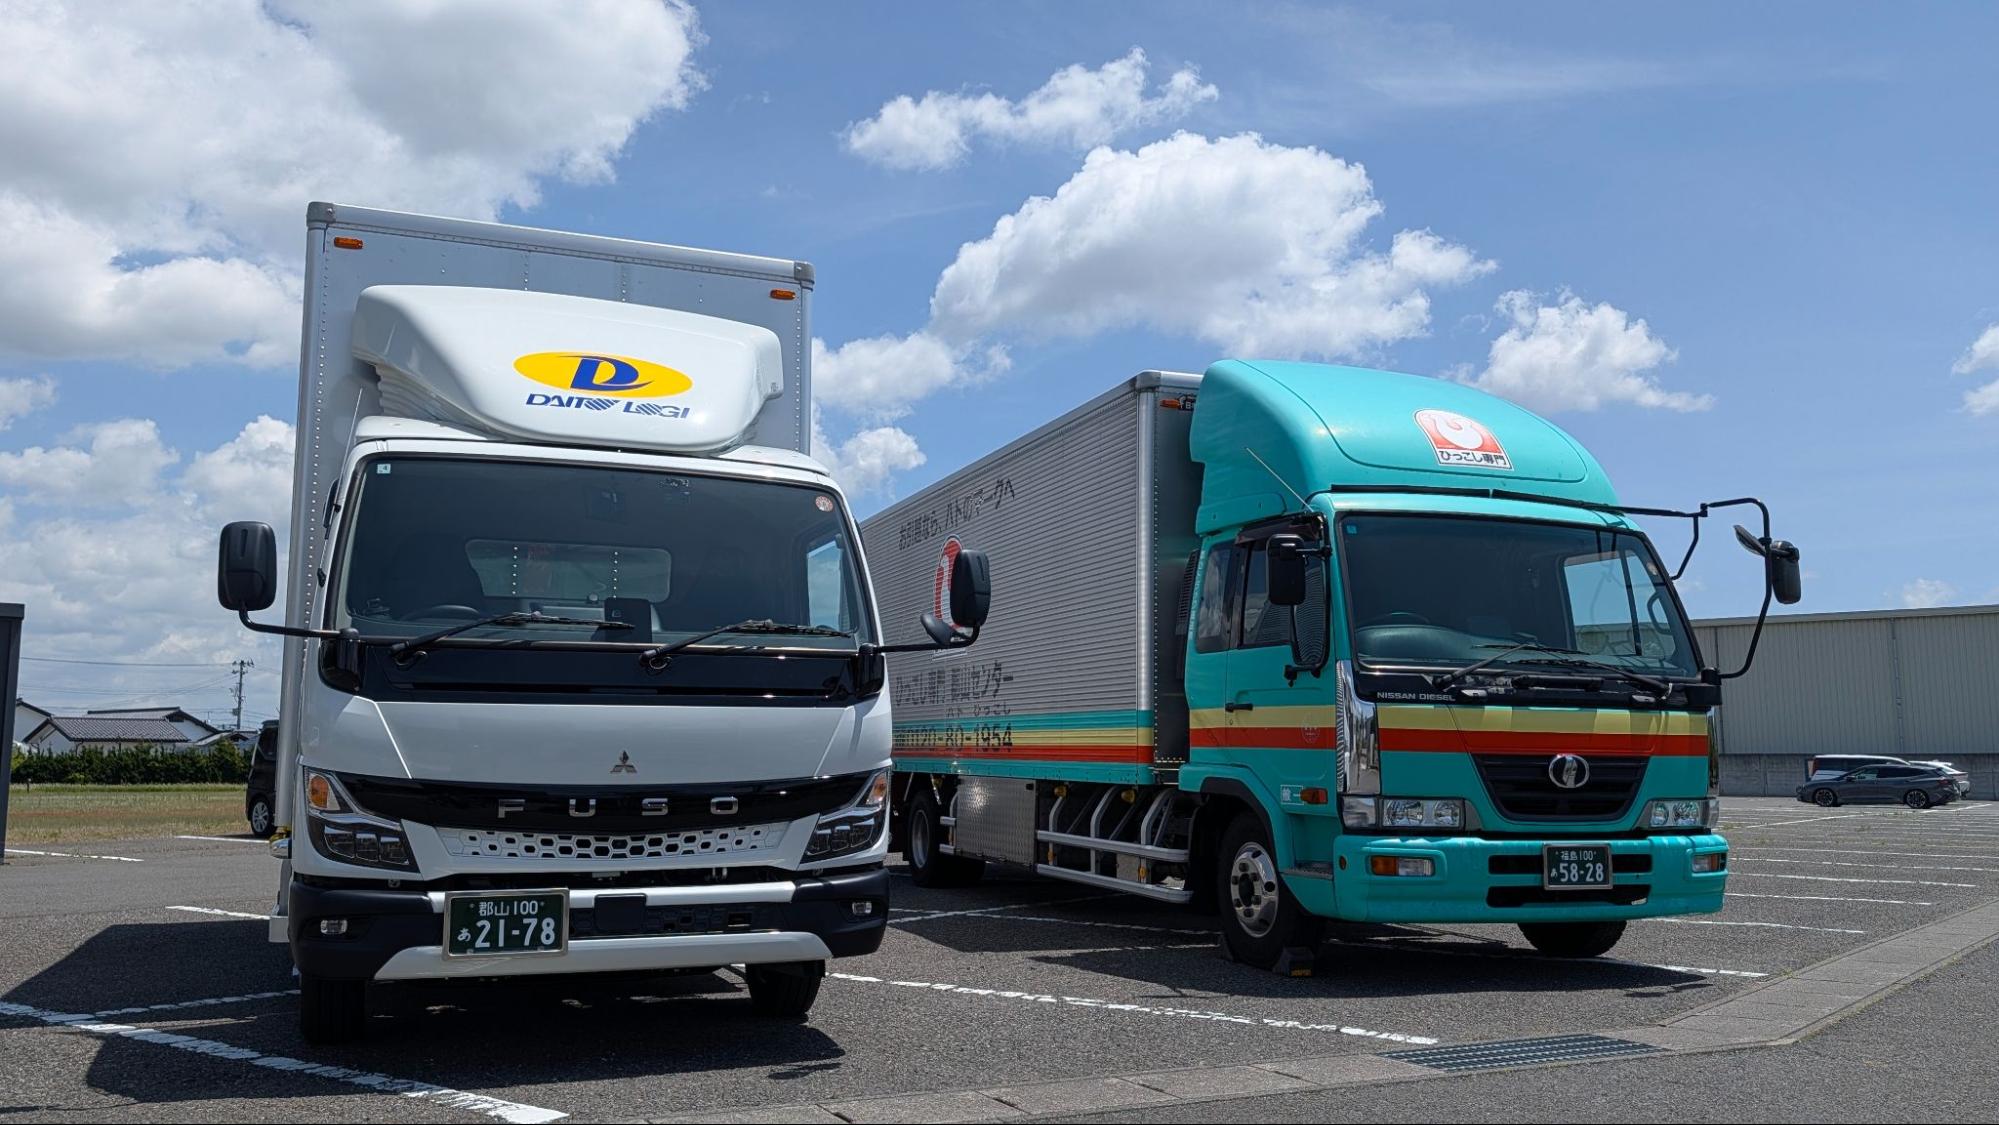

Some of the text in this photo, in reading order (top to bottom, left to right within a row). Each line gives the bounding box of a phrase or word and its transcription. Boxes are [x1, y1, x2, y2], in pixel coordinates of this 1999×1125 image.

[525, 393, 690, 419] DAITO LOGI
[1439, 450, 1507, 465] ひっこし専門
[1376, 691, 1456, 701] NISSAN DIESEL
[497, 797, 739, 819] FUSO
[478, 900, 539, 916] 郡山 100
[457, 917, 556, 948] あ 21-78
